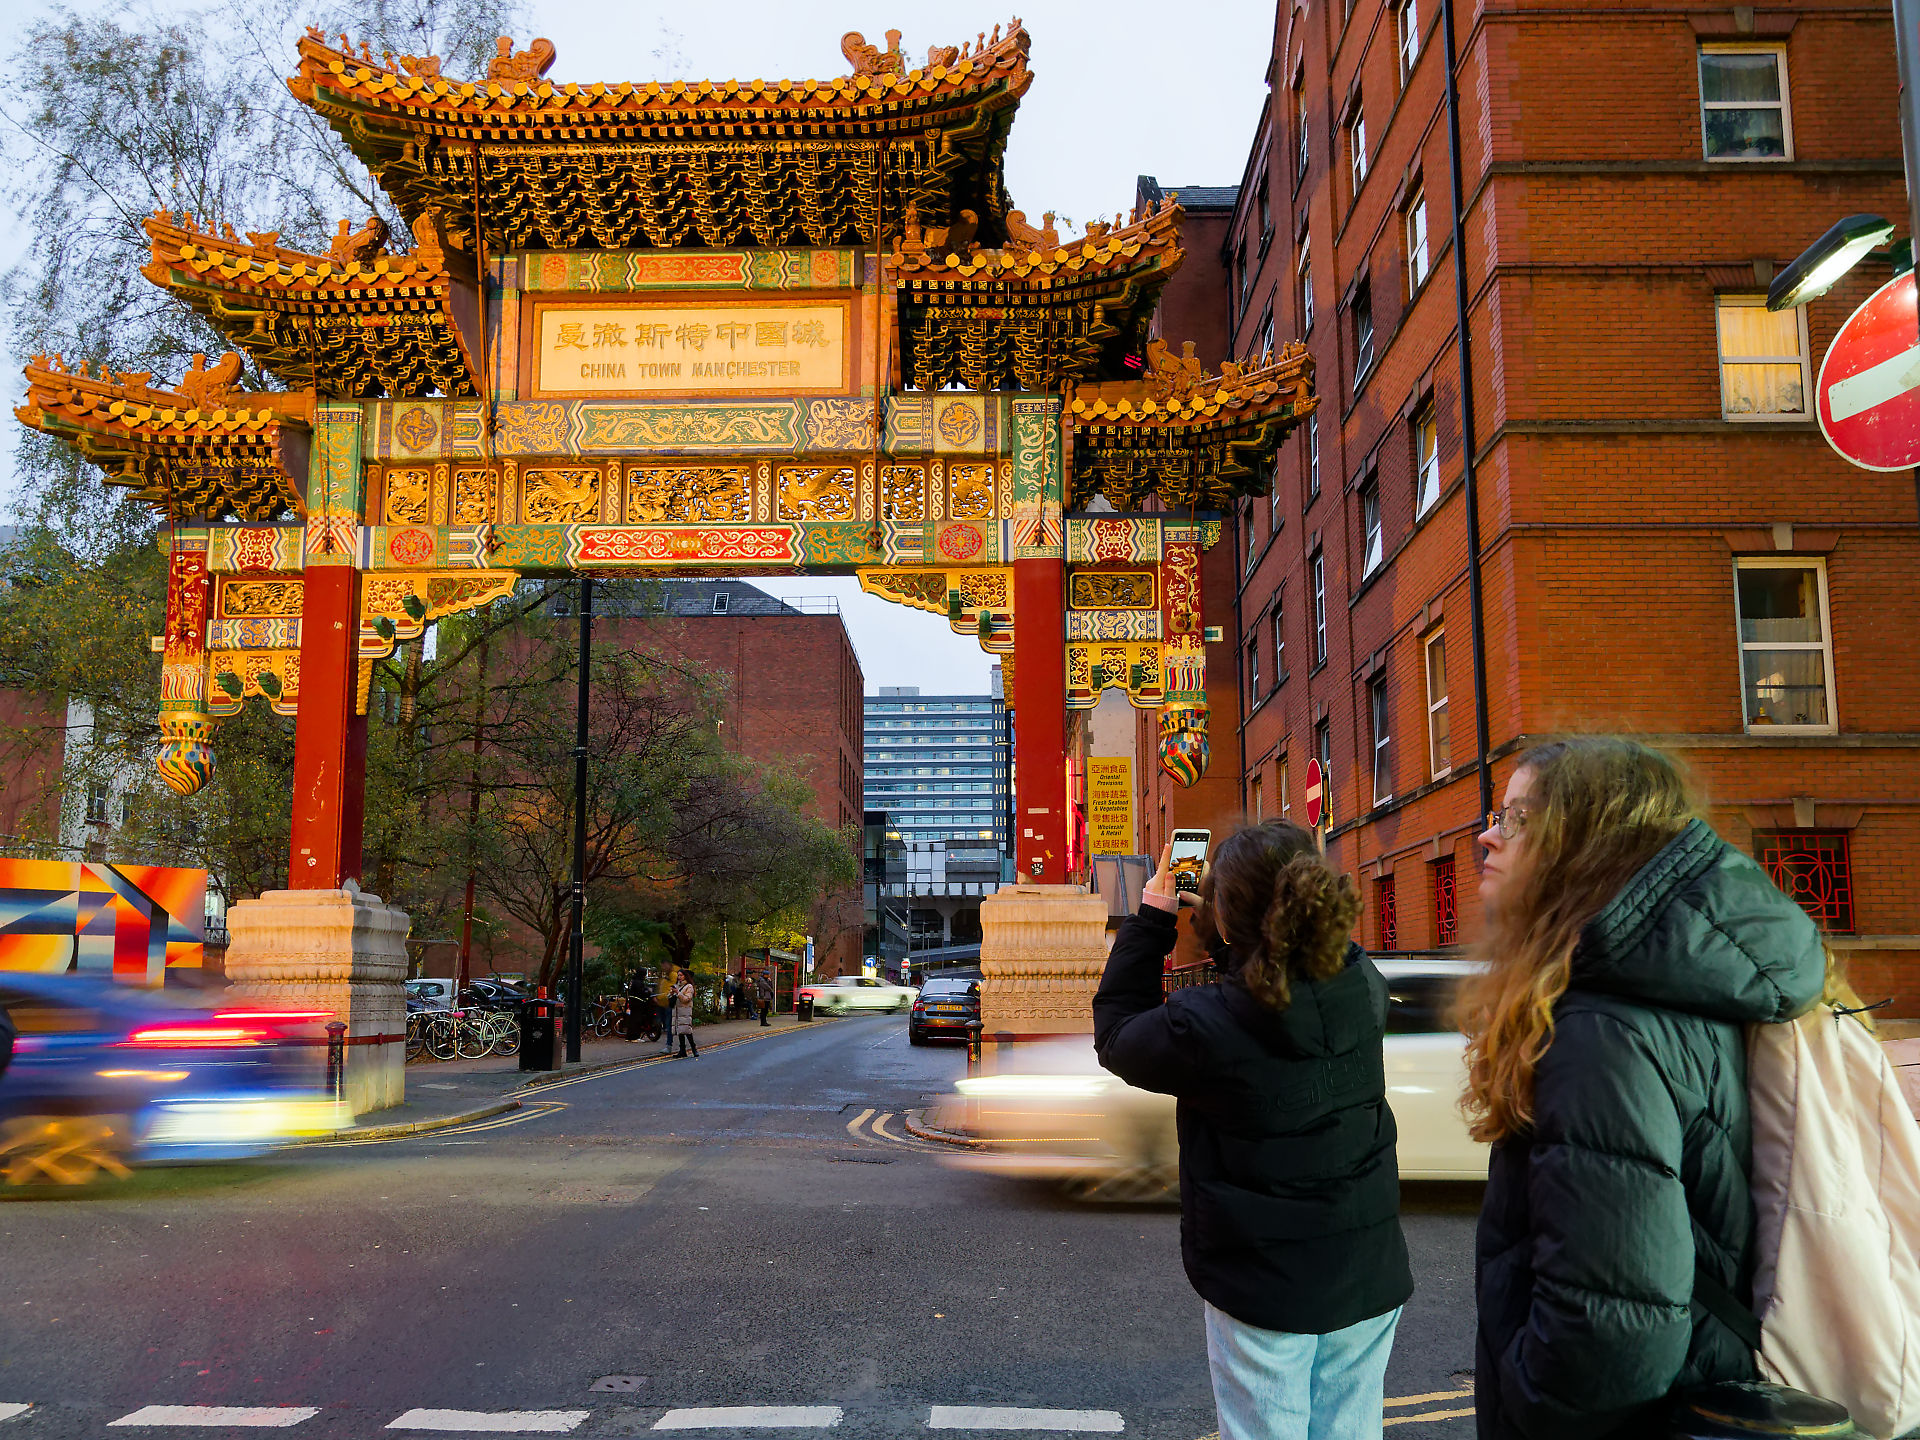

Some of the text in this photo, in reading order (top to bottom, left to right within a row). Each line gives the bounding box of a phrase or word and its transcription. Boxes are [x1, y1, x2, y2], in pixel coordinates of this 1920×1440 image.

[580, 361, 800, 379] CHINA TOWN MANCHESTER
[1091, 764, 1127, 774] 亞洲食品
